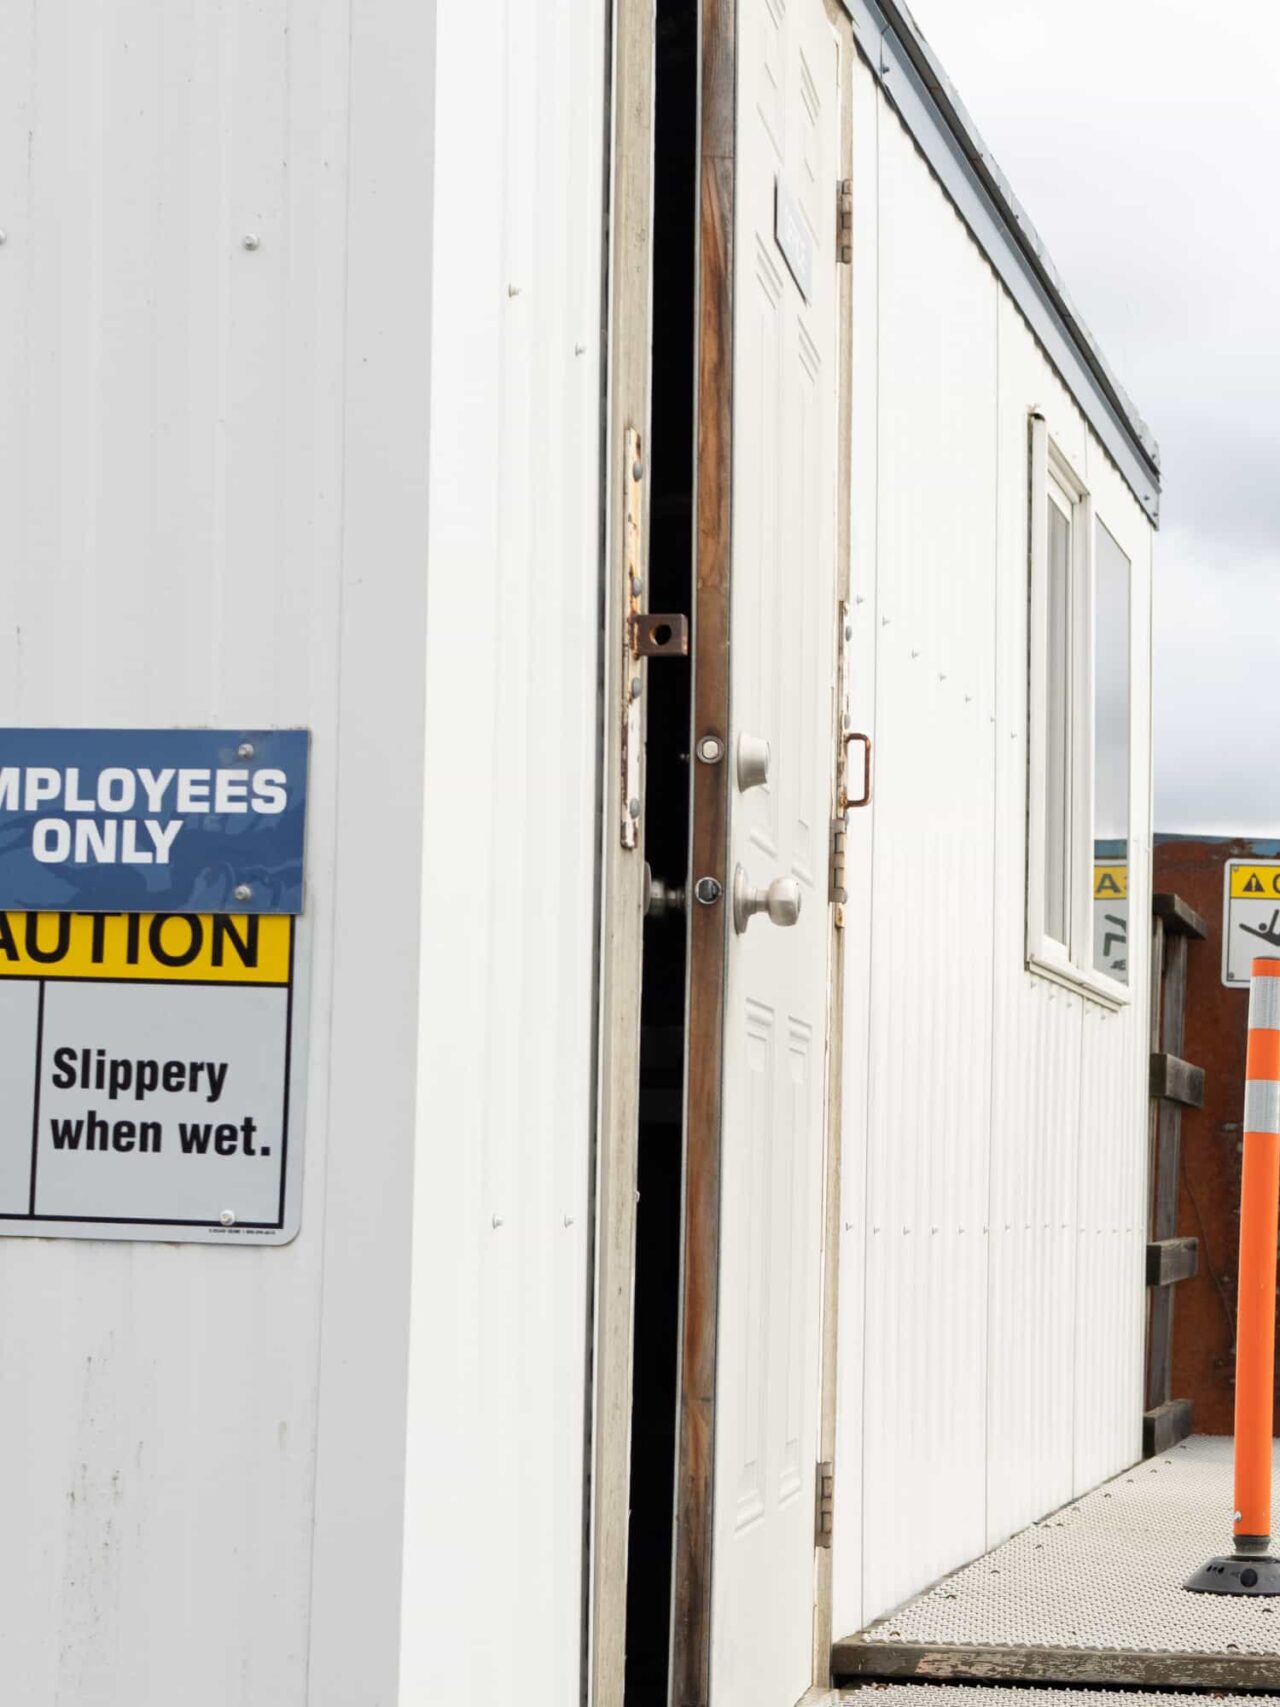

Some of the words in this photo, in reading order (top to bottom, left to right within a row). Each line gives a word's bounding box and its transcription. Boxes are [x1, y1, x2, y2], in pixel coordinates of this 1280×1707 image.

[32, 818, 183, 864] ONLY
[51, 1047, 228, 1102] Slippery
[50, 1111, 162, 1153] when
[179, 1116, 271, 1156] wet.
